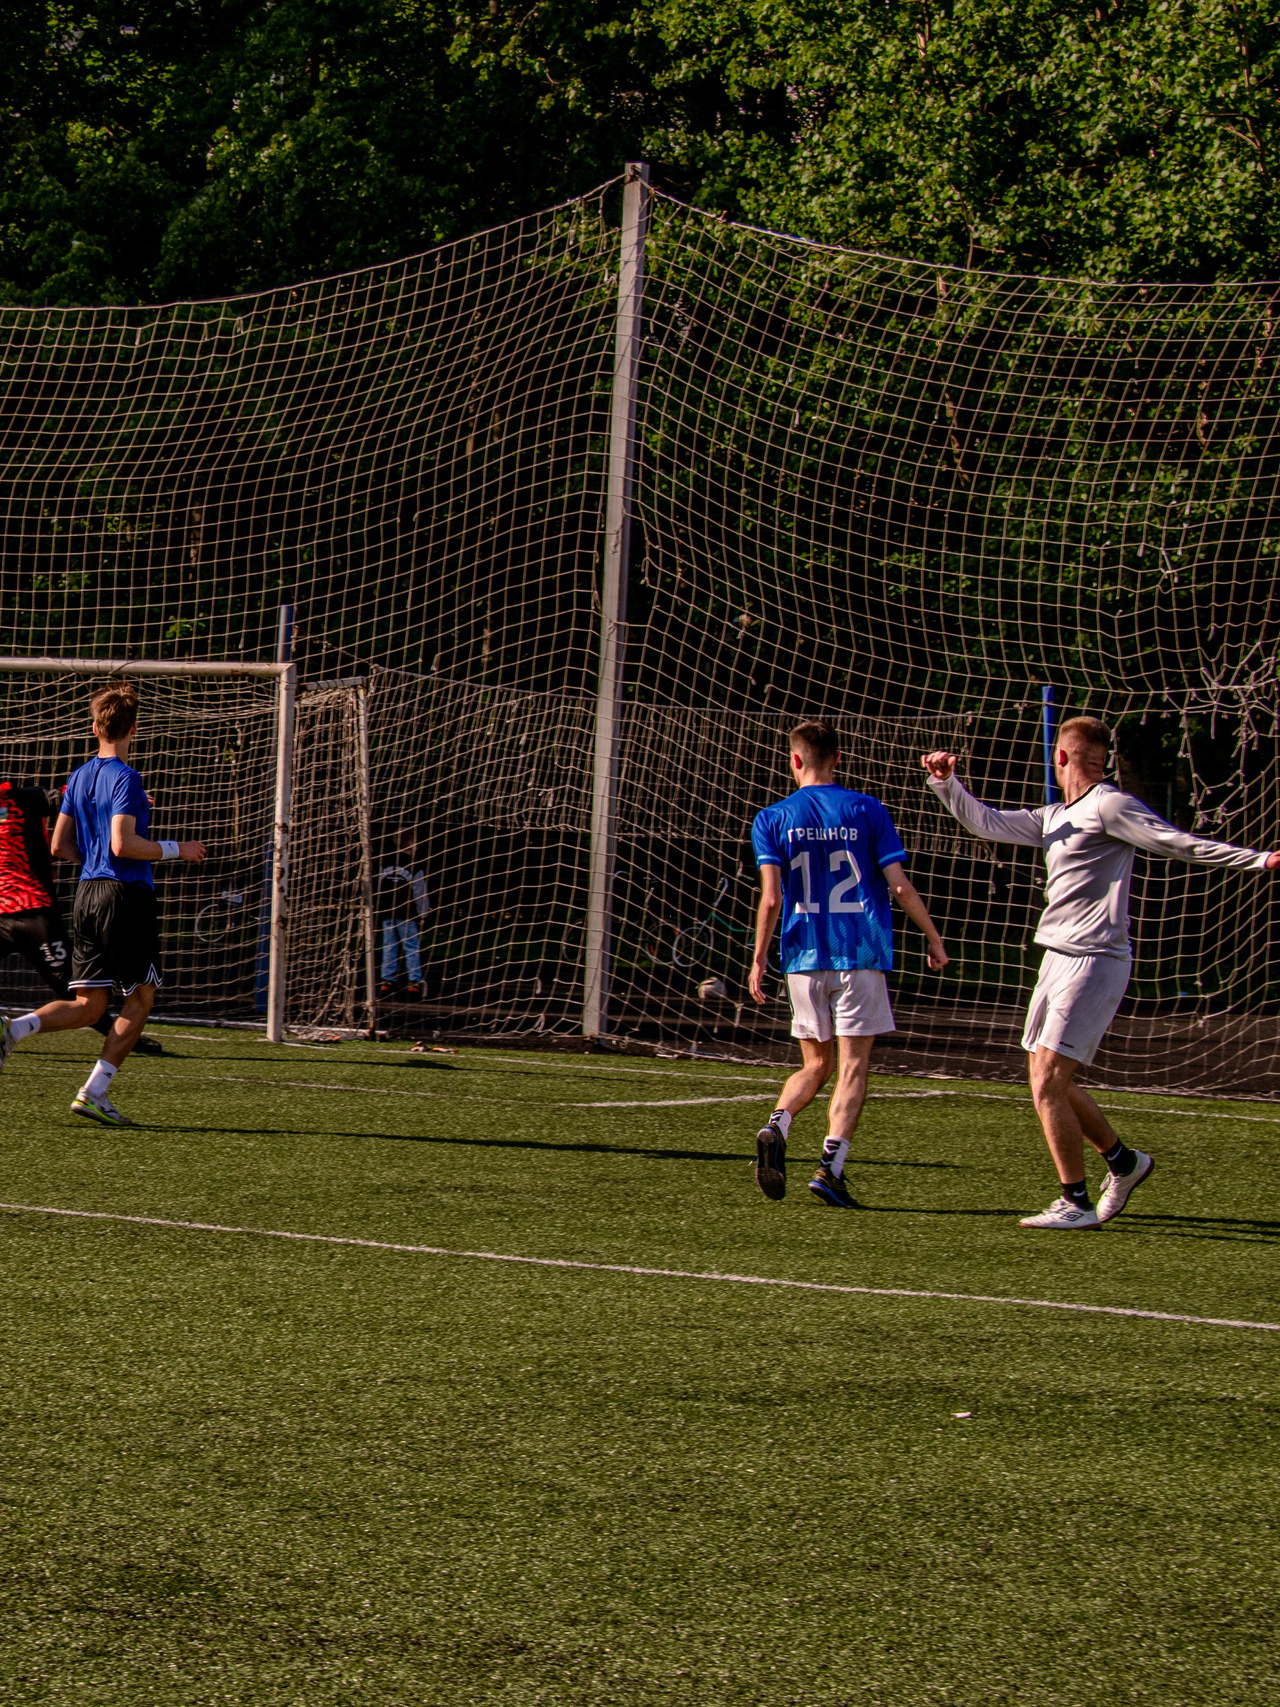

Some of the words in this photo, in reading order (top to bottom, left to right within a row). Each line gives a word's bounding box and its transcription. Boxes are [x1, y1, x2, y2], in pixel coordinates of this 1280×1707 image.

[787, 826, 858, 843] ГРЕШНОВ
[790, 849, 865, 914] 12
[39, 940, 68, 962] 13
